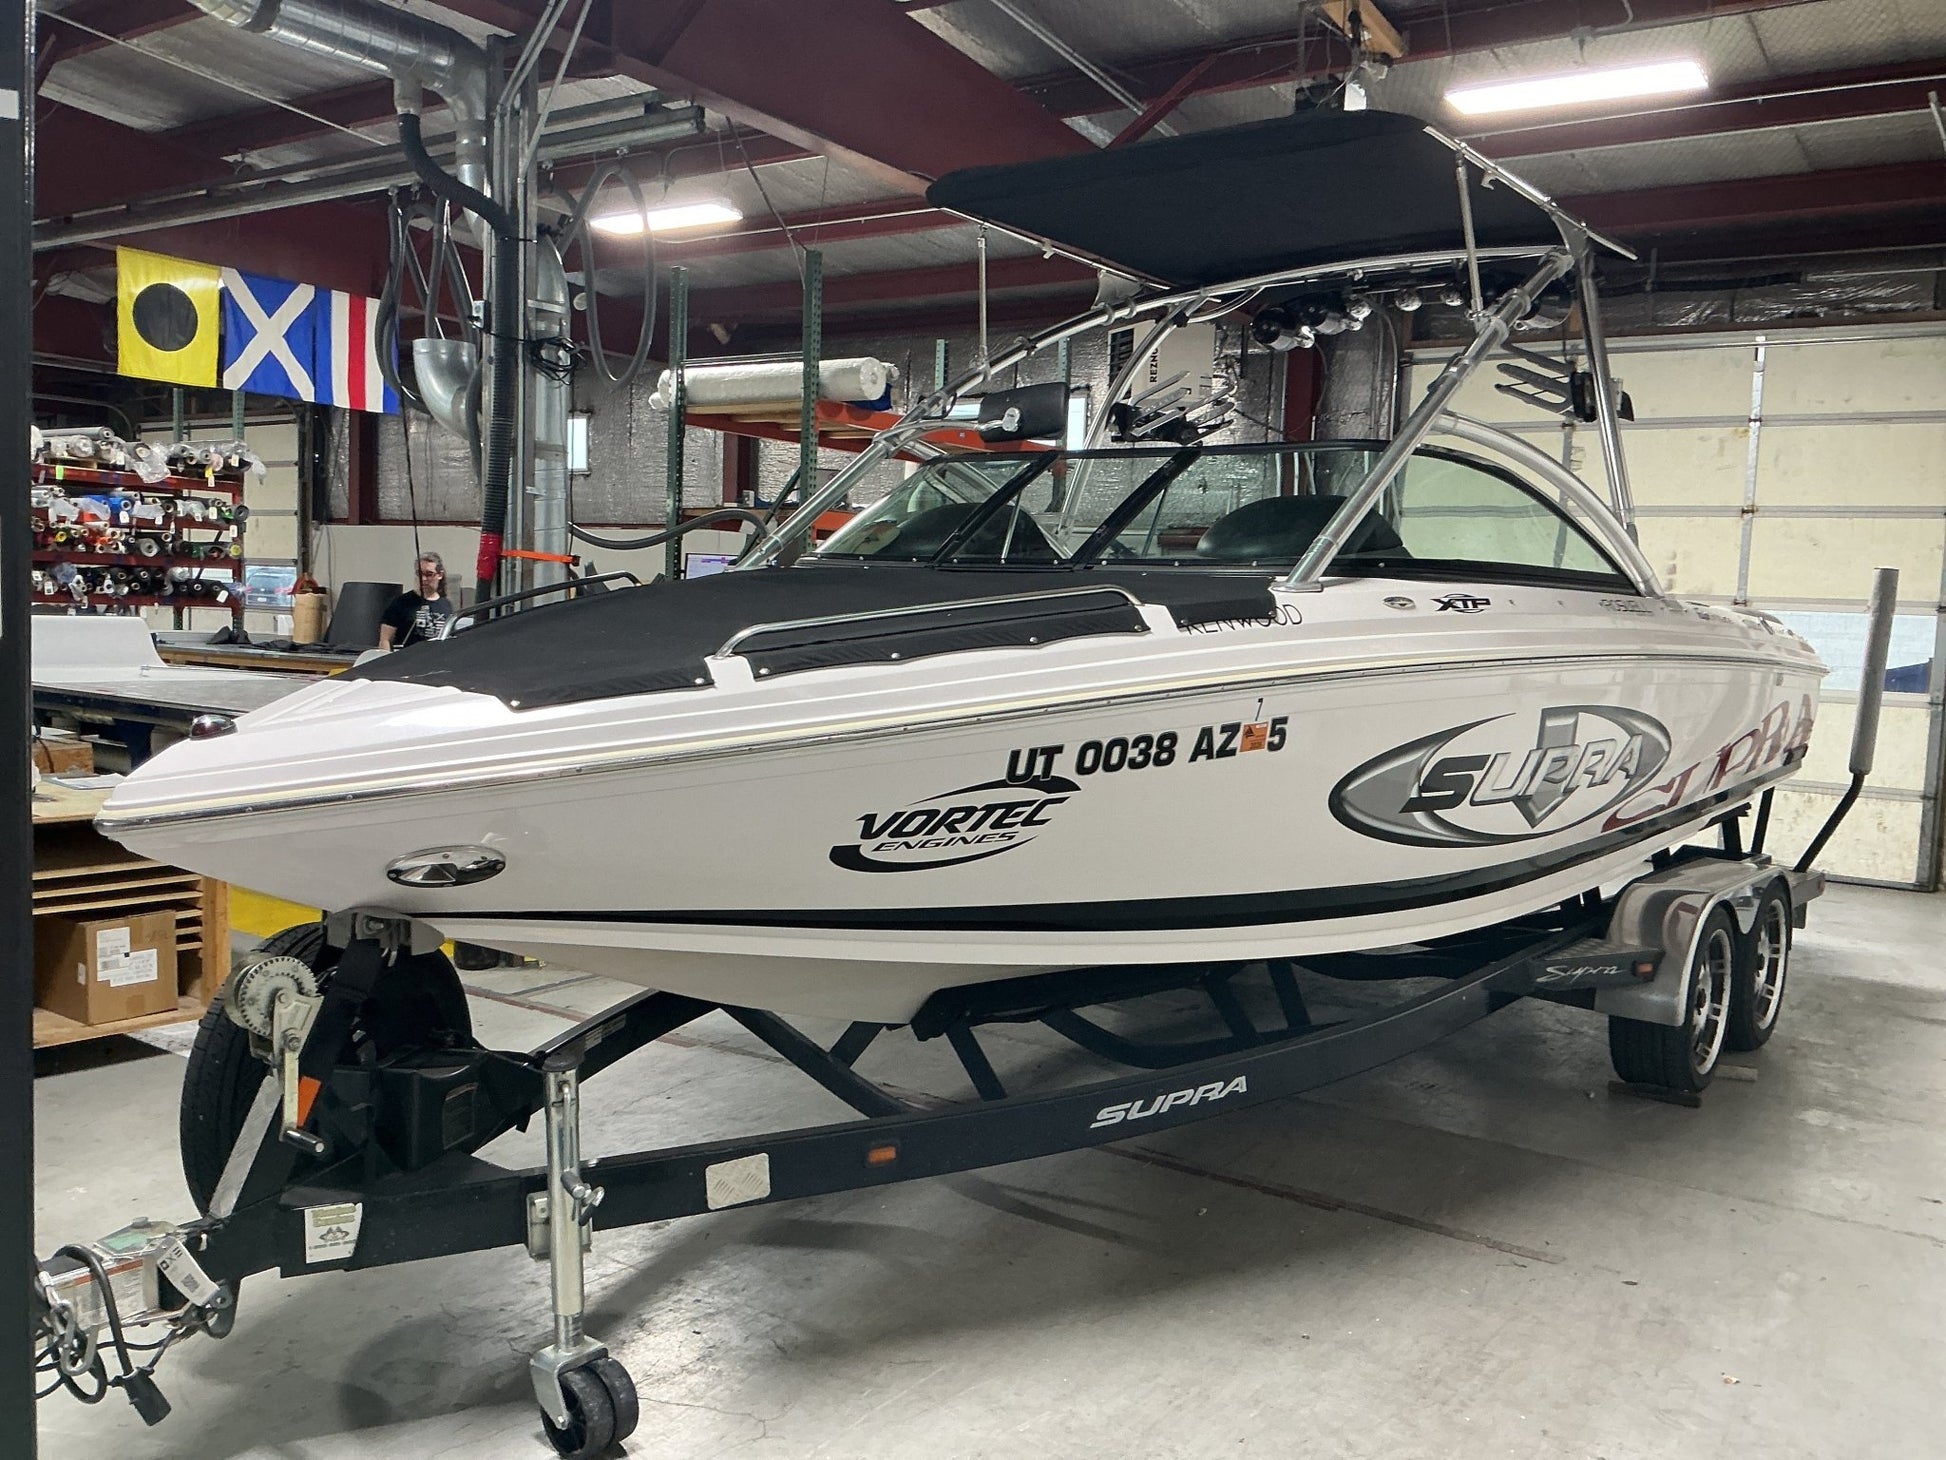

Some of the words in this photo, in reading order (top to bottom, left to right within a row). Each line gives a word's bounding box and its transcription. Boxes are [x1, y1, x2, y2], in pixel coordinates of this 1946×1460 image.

[1429, 596, 1492, 612] XTP
[1006, 744, 1065, 784] UT
[1075, 731, 1178, 775] 0038
[1188, 722, 1242, 763] AZ
[1398, 733, 1643, 813] SUPRA
[855, 796, 1070, 840] VORTEC
[871, 830, 1020, 852] ENGINES
[1535, 965, 1627, 984] Supra
[1089, 1075, 1248, 1129] SUPRA
